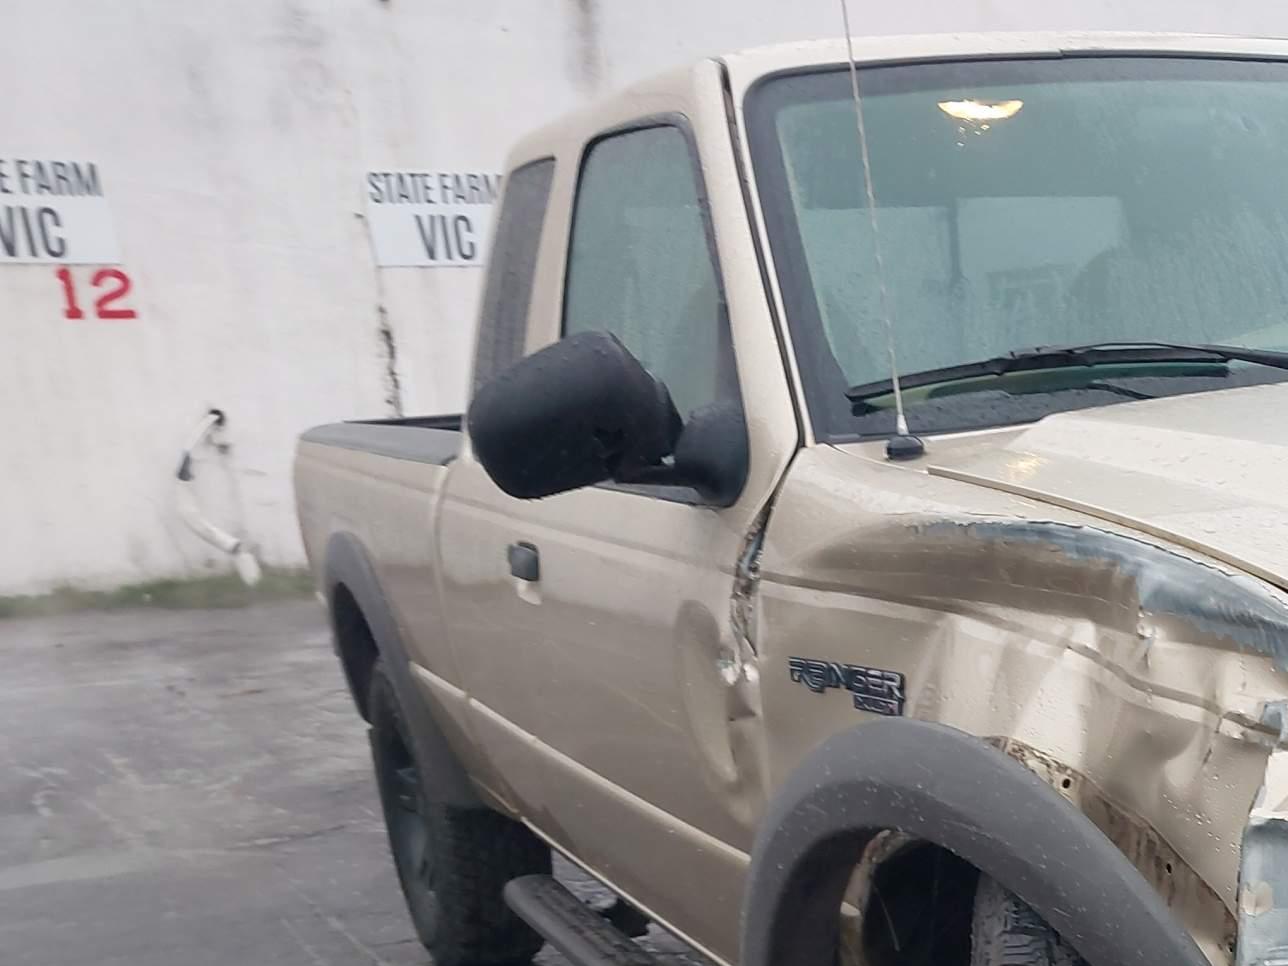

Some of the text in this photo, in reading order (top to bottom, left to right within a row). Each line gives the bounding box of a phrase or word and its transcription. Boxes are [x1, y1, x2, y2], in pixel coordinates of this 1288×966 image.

[15, 160, 103, 196] FARM
[368, 172, 434, 204] STATE
[0, 206, 67, 258] VIC
[414, 214, 475, 261] VIC
[55, 267, 138, 319] 12
[788, 656, 905, 701] RANGER
